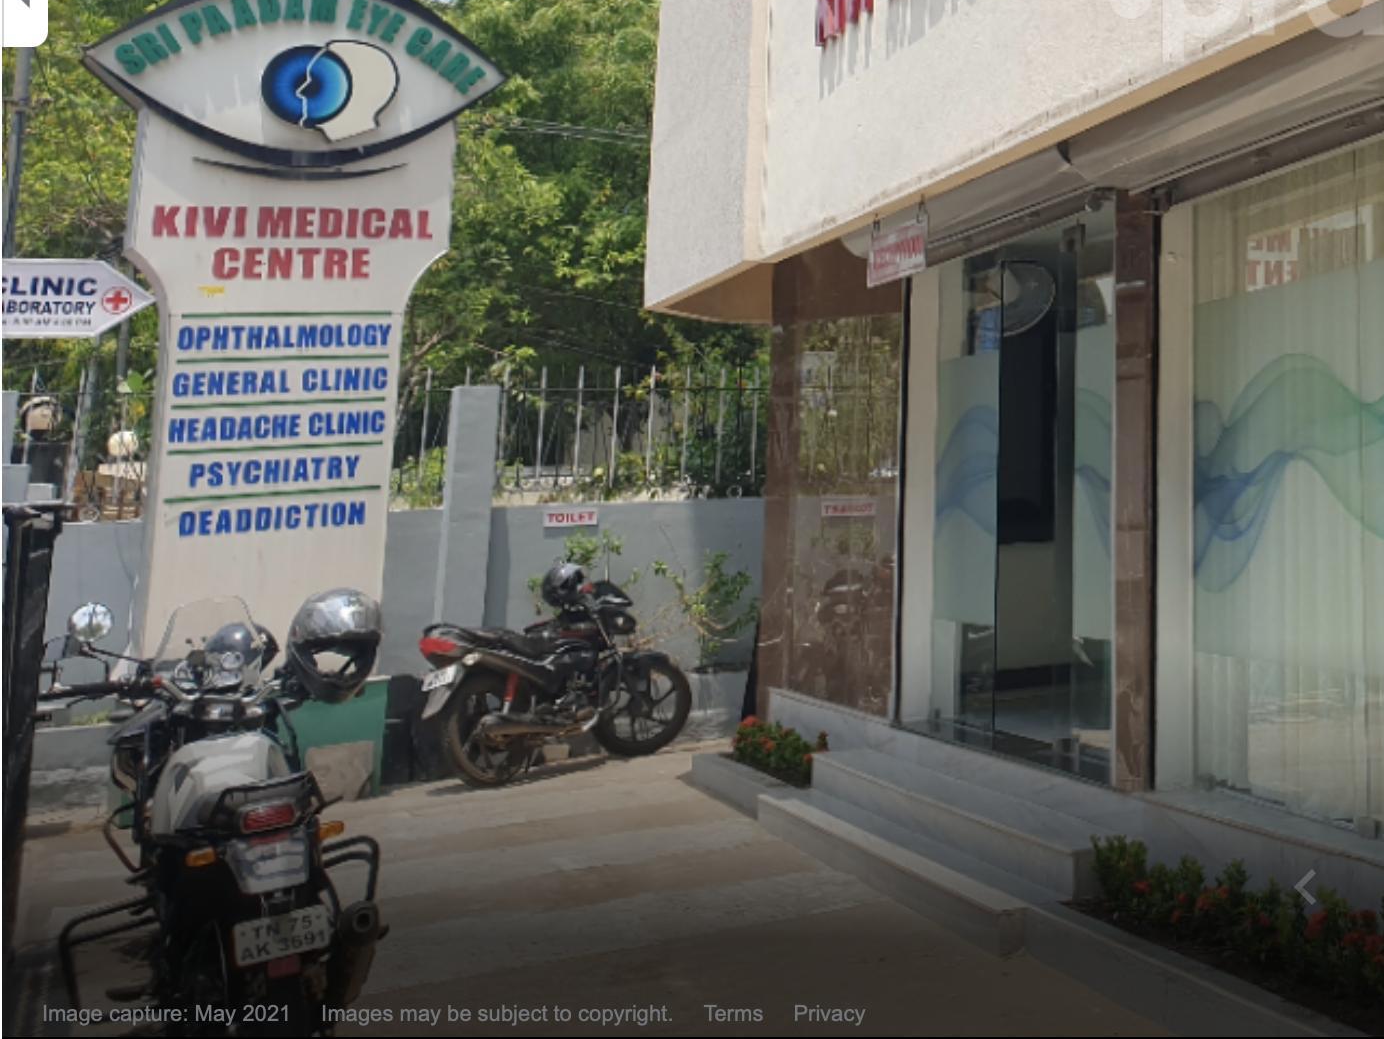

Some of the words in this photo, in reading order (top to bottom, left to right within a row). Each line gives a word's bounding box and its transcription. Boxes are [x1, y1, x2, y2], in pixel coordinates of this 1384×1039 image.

[114, 23, 182, 76] SRI
[405, 26, 488, 95] CARE
[152, 205, 248, 238] KIVI
[256, 206, 433, 239] MEDICAL
[212, 247, 370, 280] CENTRE
[2, 299, 96, 315] BORATORY
[176, 324, 392, 351] OPHTHALMOLOGY
[172, 369, 290, 397] GENERAL
[302, 366, 388, 392] CLINIC
[168, 414, 301, 443] HEADACHE
[308, 410, 386, 436] CLINIC
[189, 455, 360, 488] PSYCHIATRY
[179, 501, 366, 537] DEADDICTION
[546, 510, 595, 523] TOILET
[253, 921, 280, 940] TN
[241, 942, 270, 961] AK
